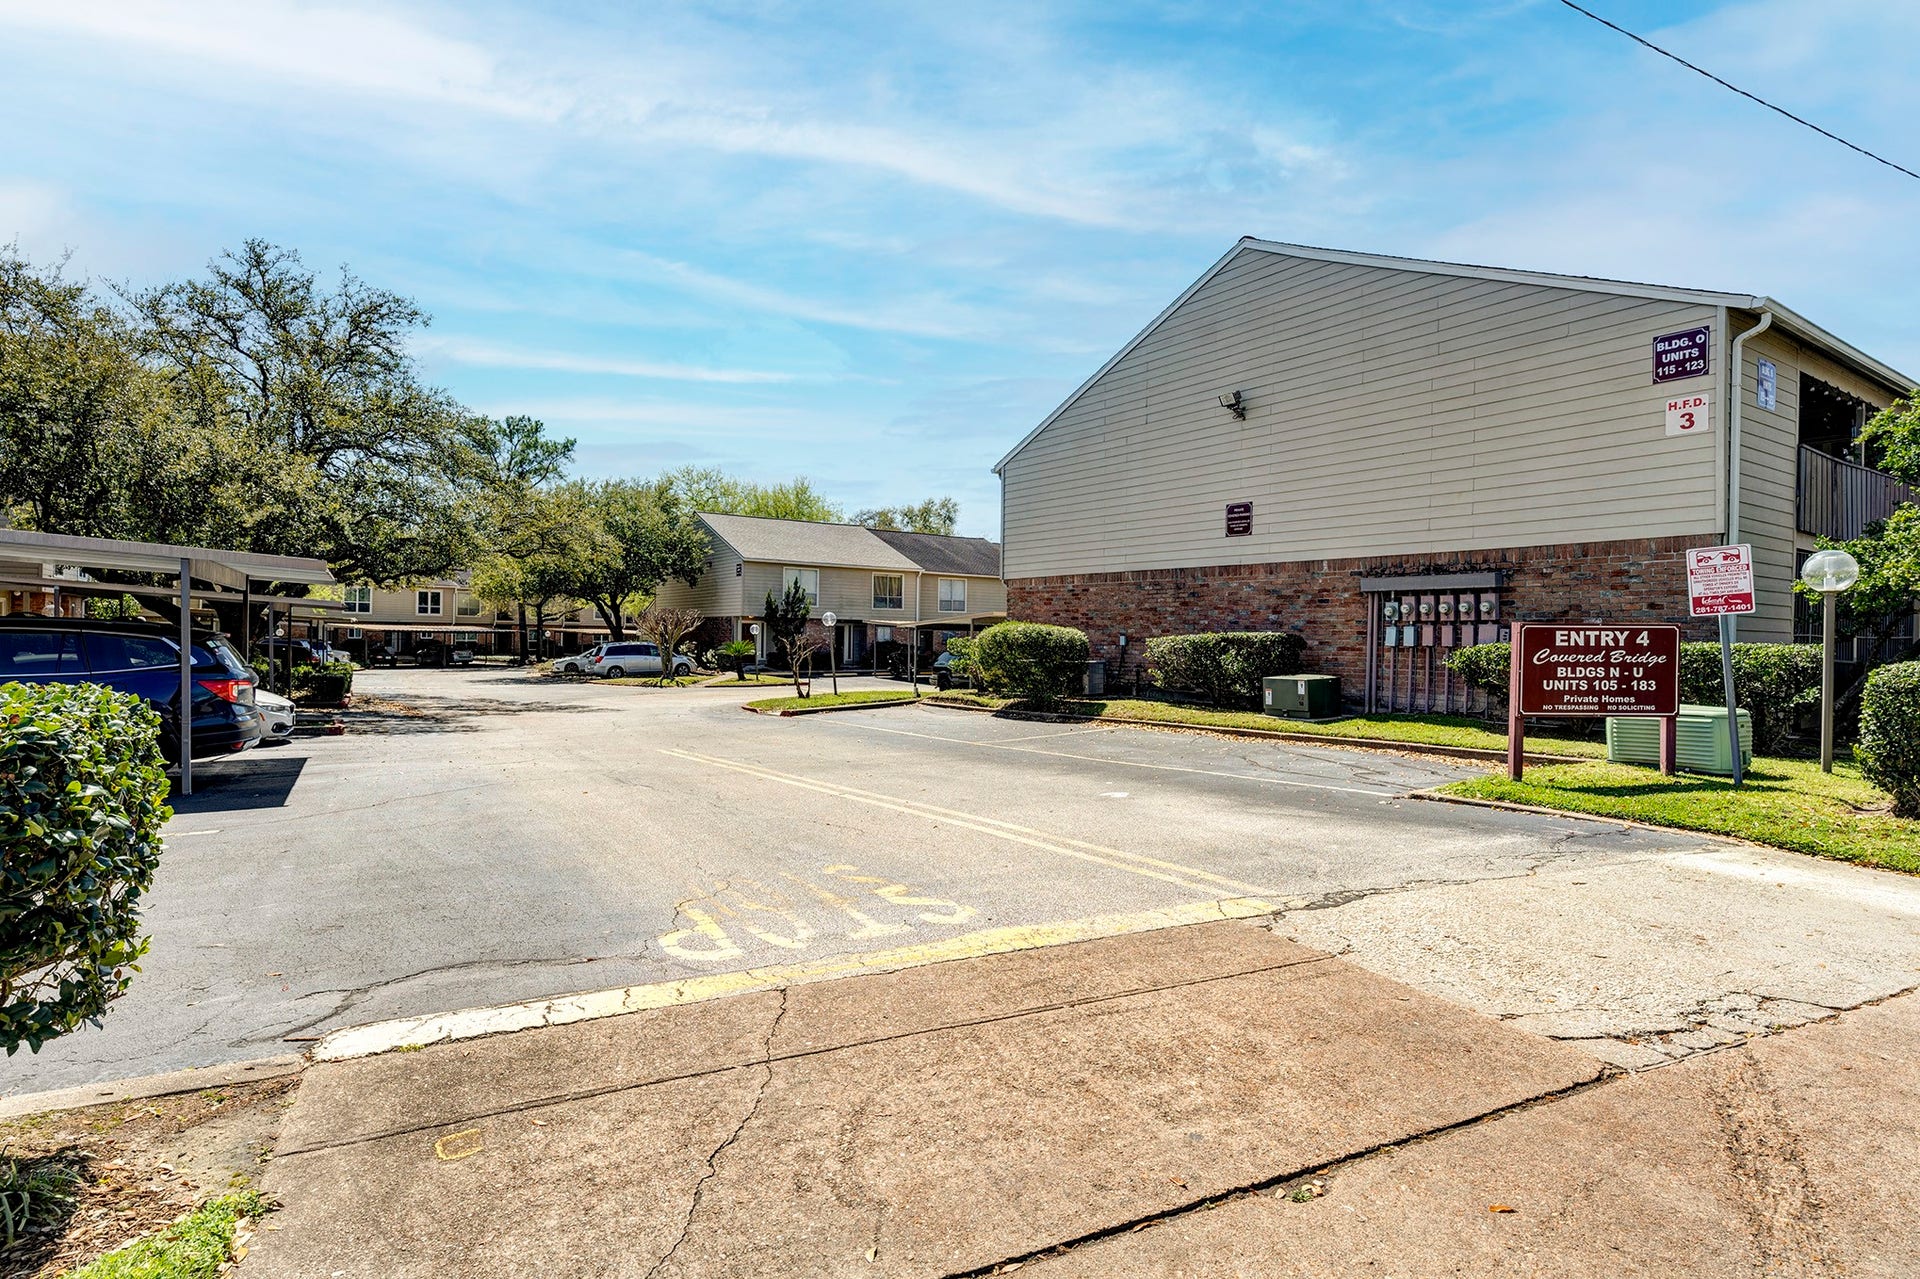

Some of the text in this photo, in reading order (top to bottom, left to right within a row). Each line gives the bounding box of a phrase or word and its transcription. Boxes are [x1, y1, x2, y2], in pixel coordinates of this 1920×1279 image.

[1656, 334, 1705, 352] BLDG. O
[1662, 348, 1699, 363] UNITS
[1657, 365, 1676, 376] 115
[1685, 360, 1704, 371] 123
[1668, 398, 1706, 411] H.F.D.
[1680, 412, 1695, 429] 3
[1692, 564, 1747, 575] TOWING ENFORCED
[1695, 604, 1751, 613] 281-787-1401
[1555, 631, 1650, 646] ENTRY 4
[1533, 649, 1667, 667] Covered Bridge
[1557, 667, 1605, 677] BLDGS
[1610, 667, 1620, 677] N
[1633, 667, 1643, 677] U
[1543, 680, 1588, 690] UNITS
[1593, 680, 1617, 690] 105
[1631, 680, 1656, 690] 183
[658, 864, 977, 961] STOP
